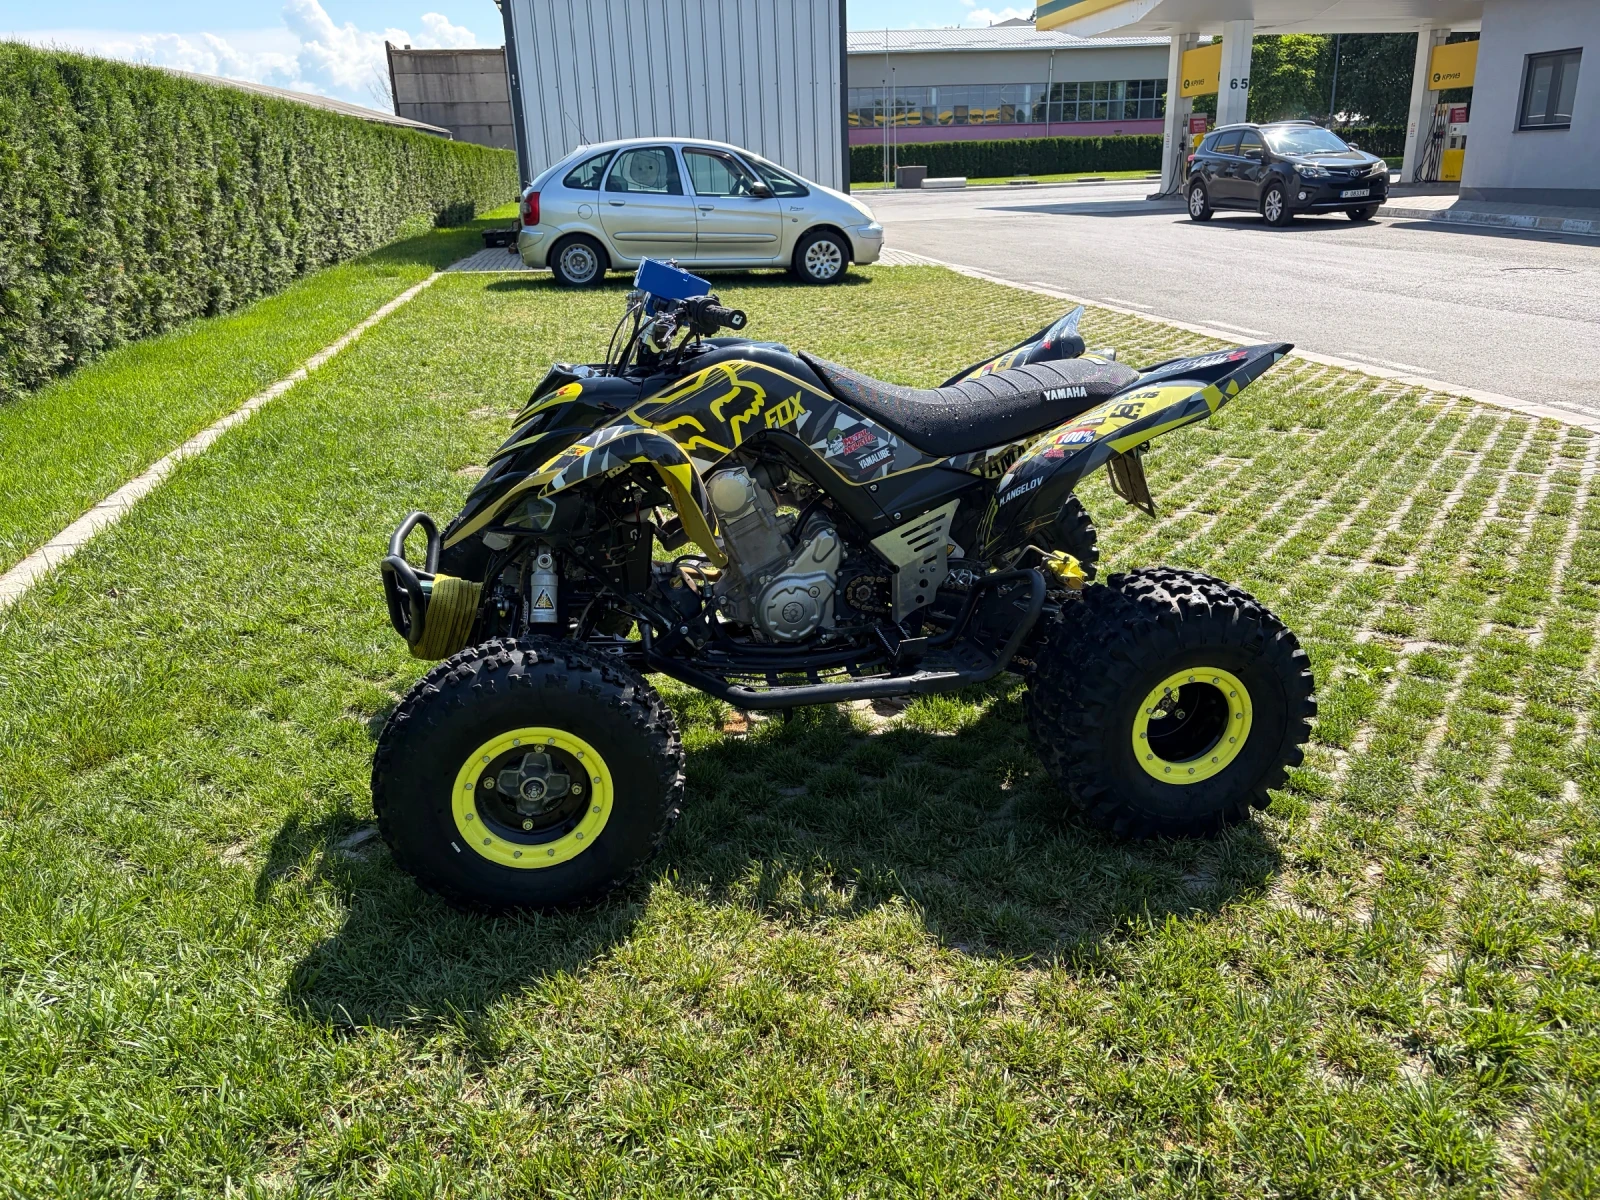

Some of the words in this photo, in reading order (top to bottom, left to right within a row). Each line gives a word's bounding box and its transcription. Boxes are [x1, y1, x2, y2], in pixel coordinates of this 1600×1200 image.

[1043, 386, 1088, 401] YAMAHA
[764, 390, 807, 429] FOX
[1059, 431, 1094, 444] 100%
[858, 447, 892, 469] YAMALUBE
